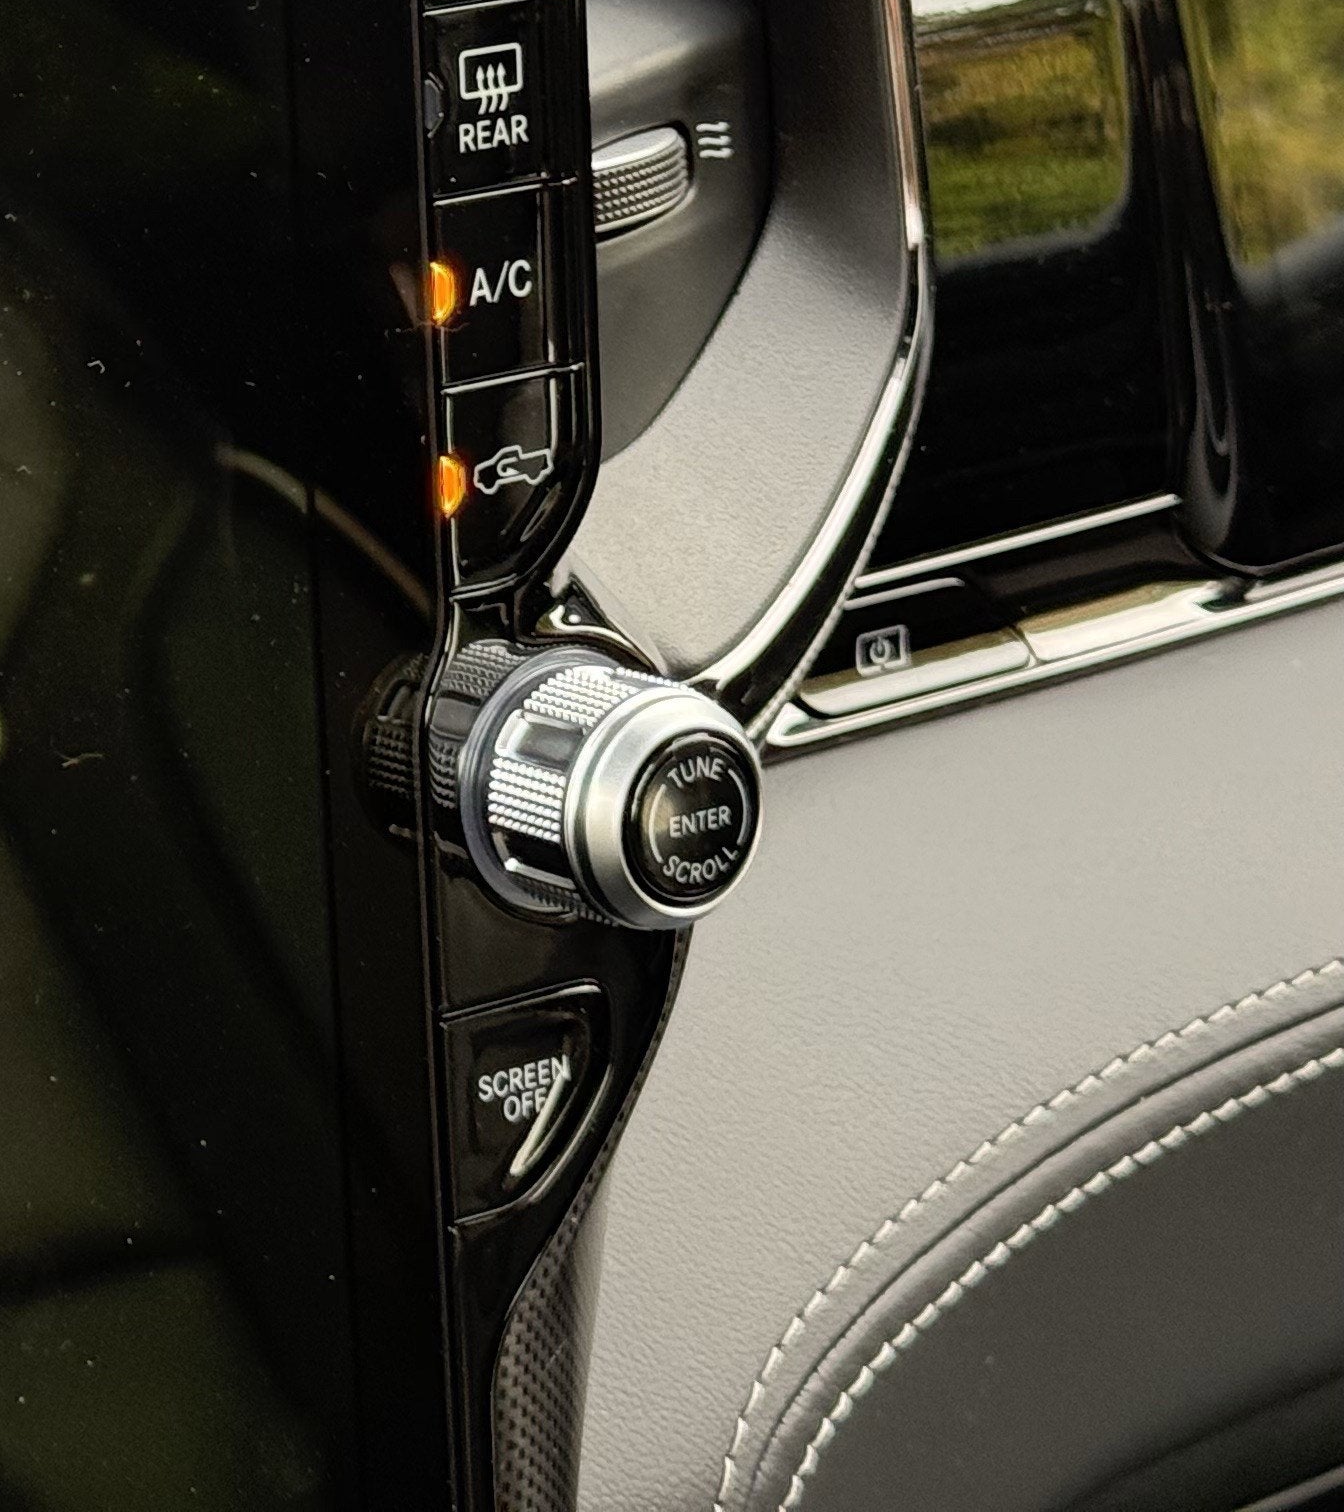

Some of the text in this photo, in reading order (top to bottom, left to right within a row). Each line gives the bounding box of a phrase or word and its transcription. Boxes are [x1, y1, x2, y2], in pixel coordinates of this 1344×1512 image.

[458, 114, 530, 153] REAR
[470, 259, 533, 307] A/C
[667, 755, 726, 788] TUNE
[669, 804, 732, 838] ENTER
[663, 846, 739, 884] SCROLL
[478, 1054, 571, 1103] SCREEN
[503, 1087, 548, 1123] OFF
